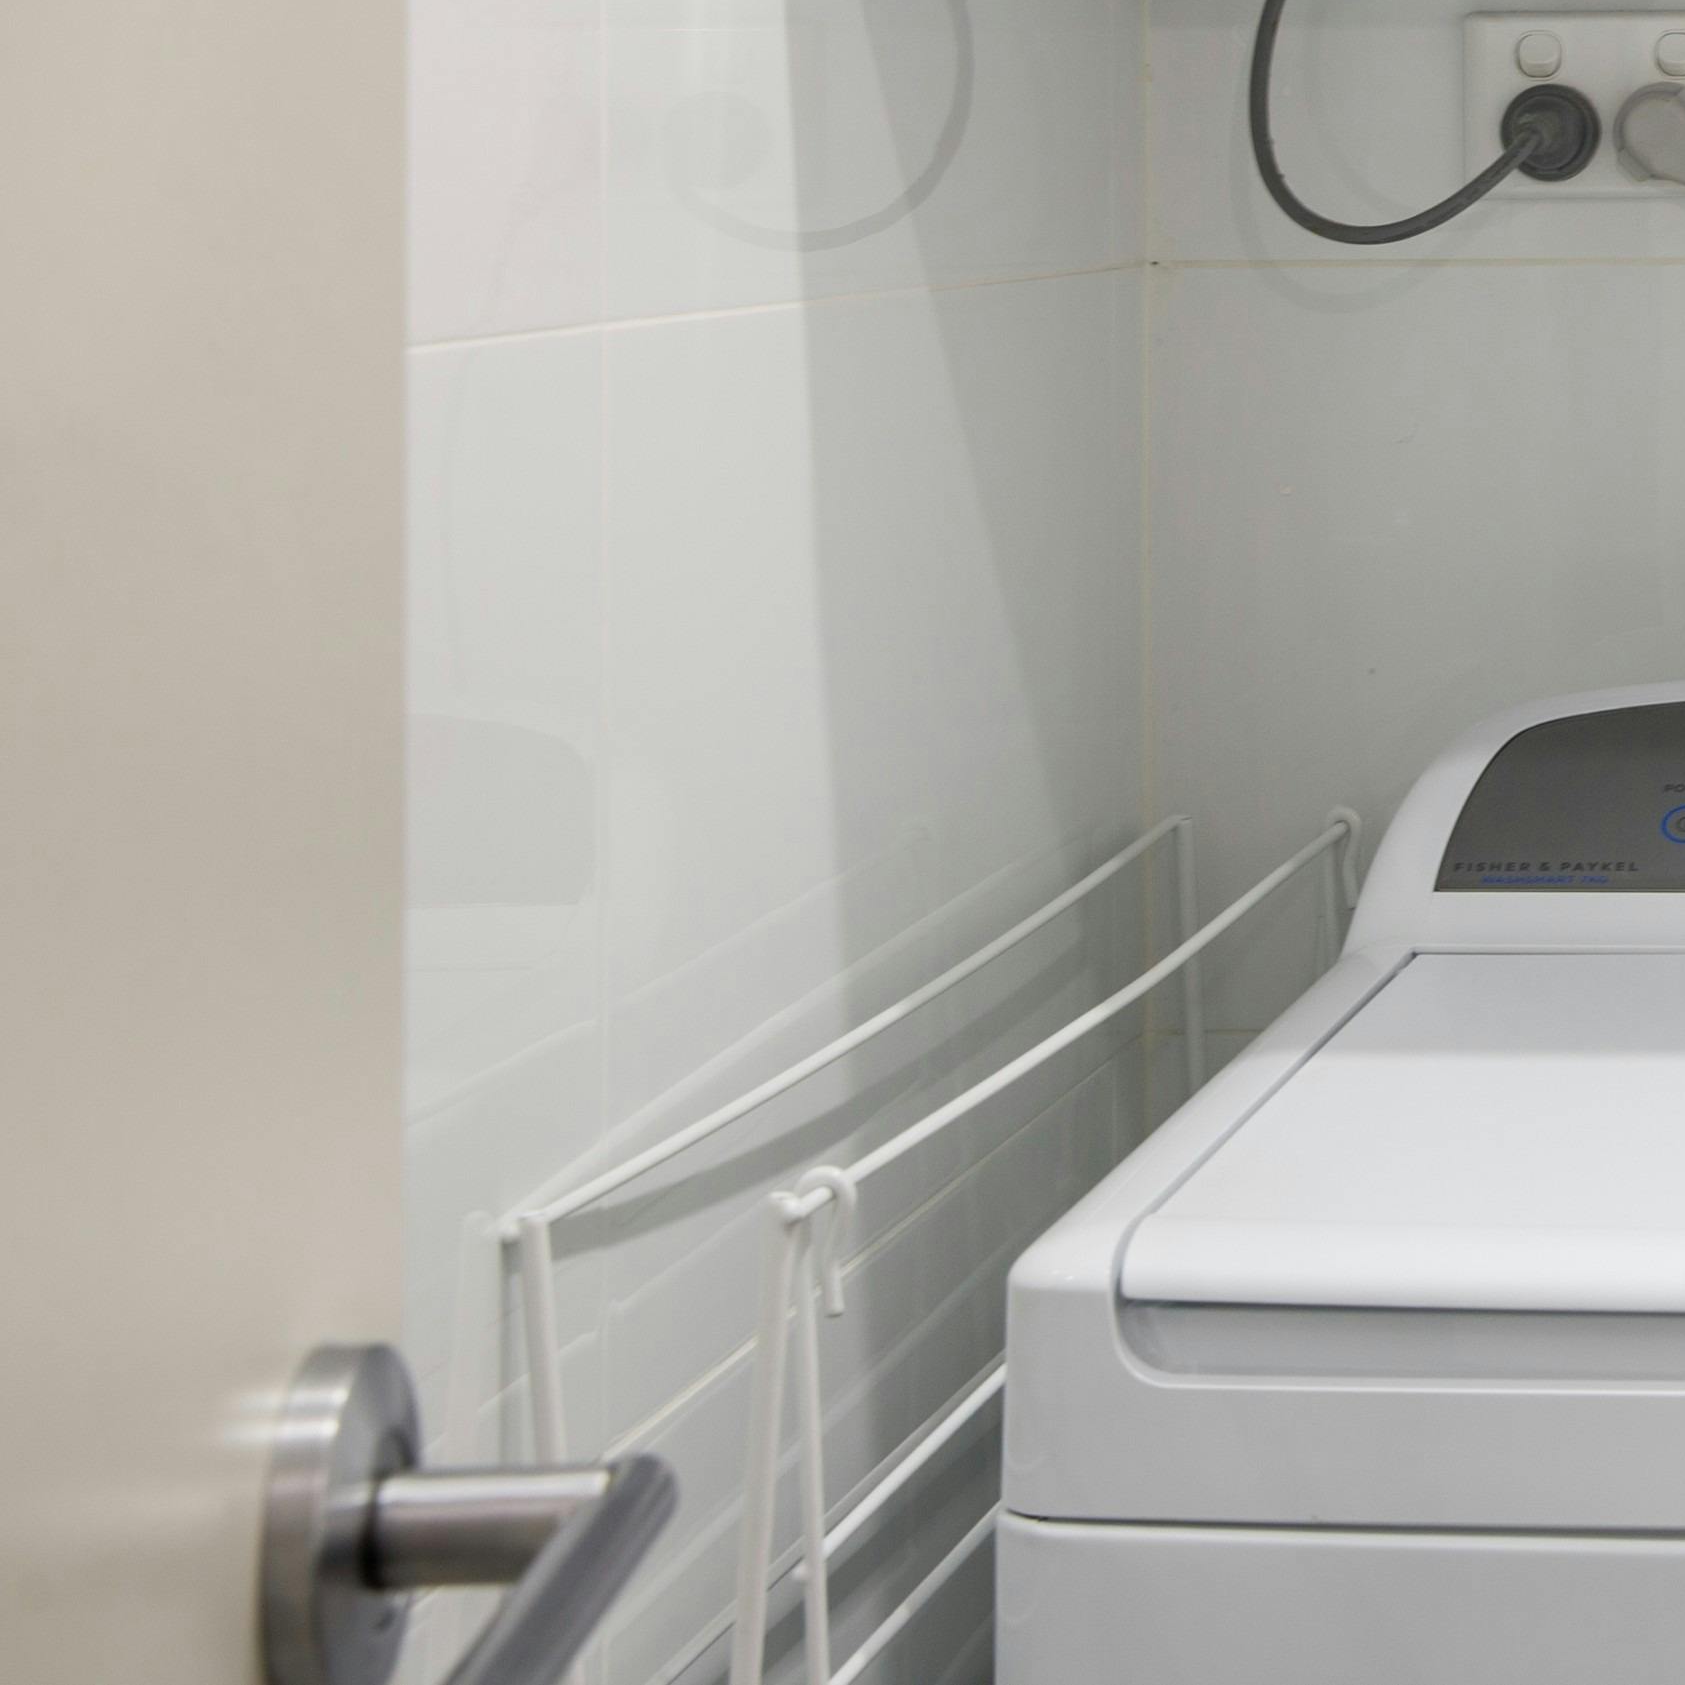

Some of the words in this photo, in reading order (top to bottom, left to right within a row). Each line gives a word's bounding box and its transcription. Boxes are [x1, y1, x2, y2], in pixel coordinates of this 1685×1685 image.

[1452, 861, 1531, 872] FISHER
[1539, 861, 1551, 872] &
[1559, 861, 1639, 872] PAYKEL
